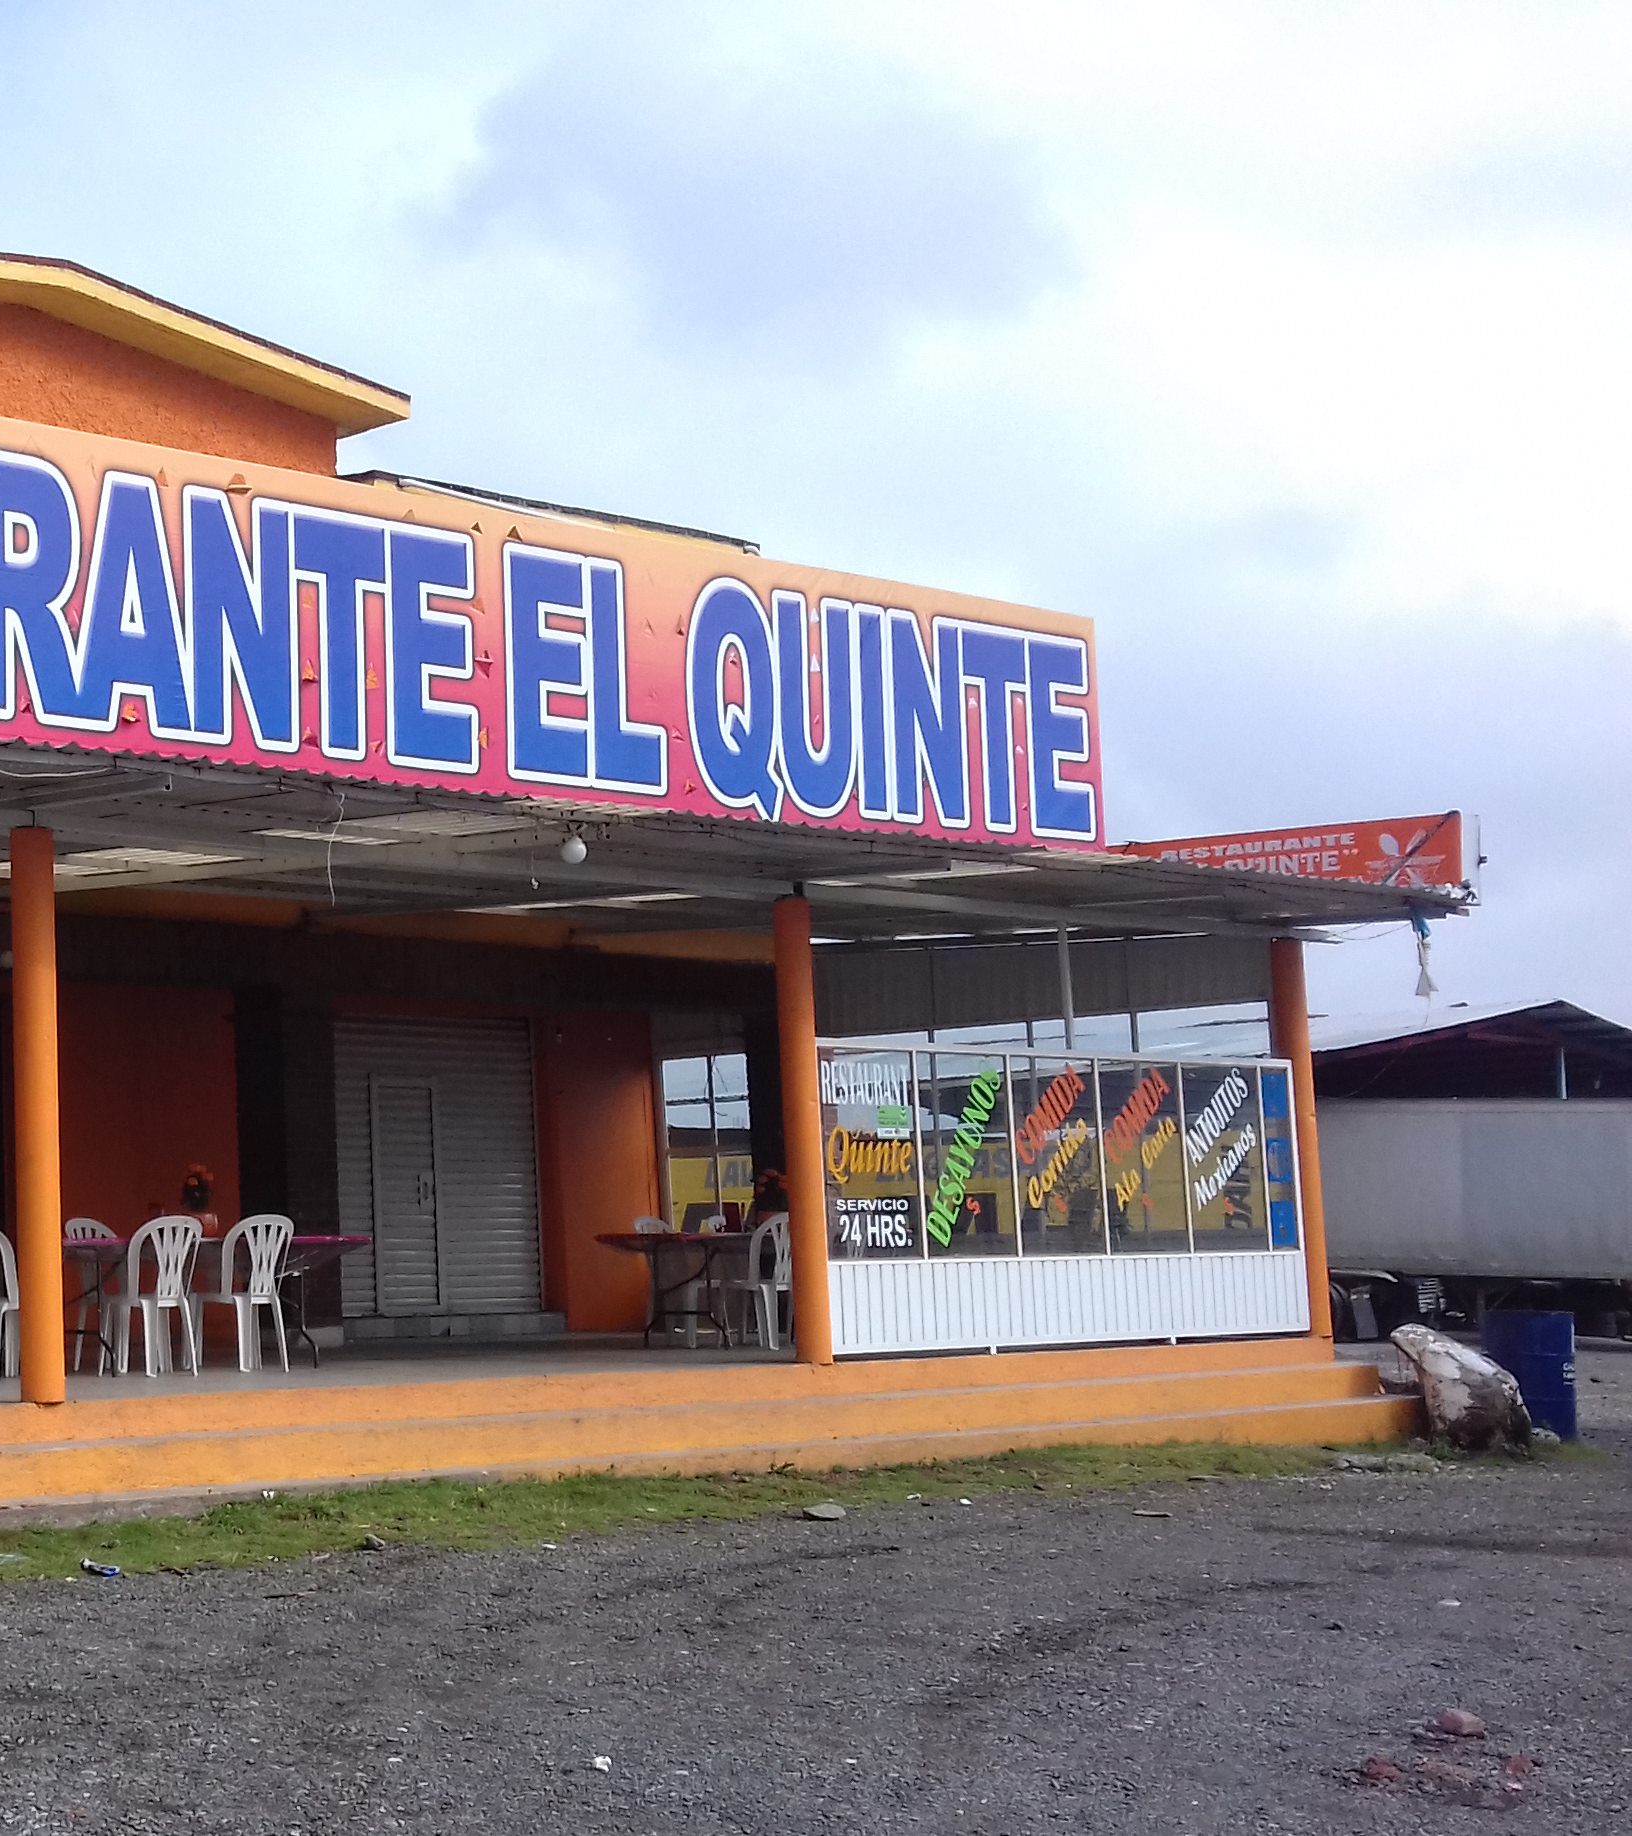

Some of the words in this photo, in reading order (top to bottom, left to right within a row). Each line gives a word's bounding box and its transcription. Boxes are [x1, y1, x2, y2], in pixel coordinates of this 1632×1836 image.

[503, 541, 668, 797] EL
[686, 576, 1097, 842] QUINTE
[1160, 832, 1356, 863] RESTAURANTE
[820, 1060, 909, 1106] RESTAURANT
[1016, 1065, 1086, 1165] COMIDA
[1104, 1067, 1171, 1165] COMIDA
[1185, 1067, 1249, 1169] ANTOJITOS
[827, 1125, 913, 1185] Quinte
[926, 1064, 1001, 1248] DESAYUNOS
[1194, 1122, 1258, 1212] Mexicanos
[836, 1198, 909, 1212] SERVICIO
[839, 1214, 862, 1248] 24
[866, 1213, 913, 1248] HRS.
